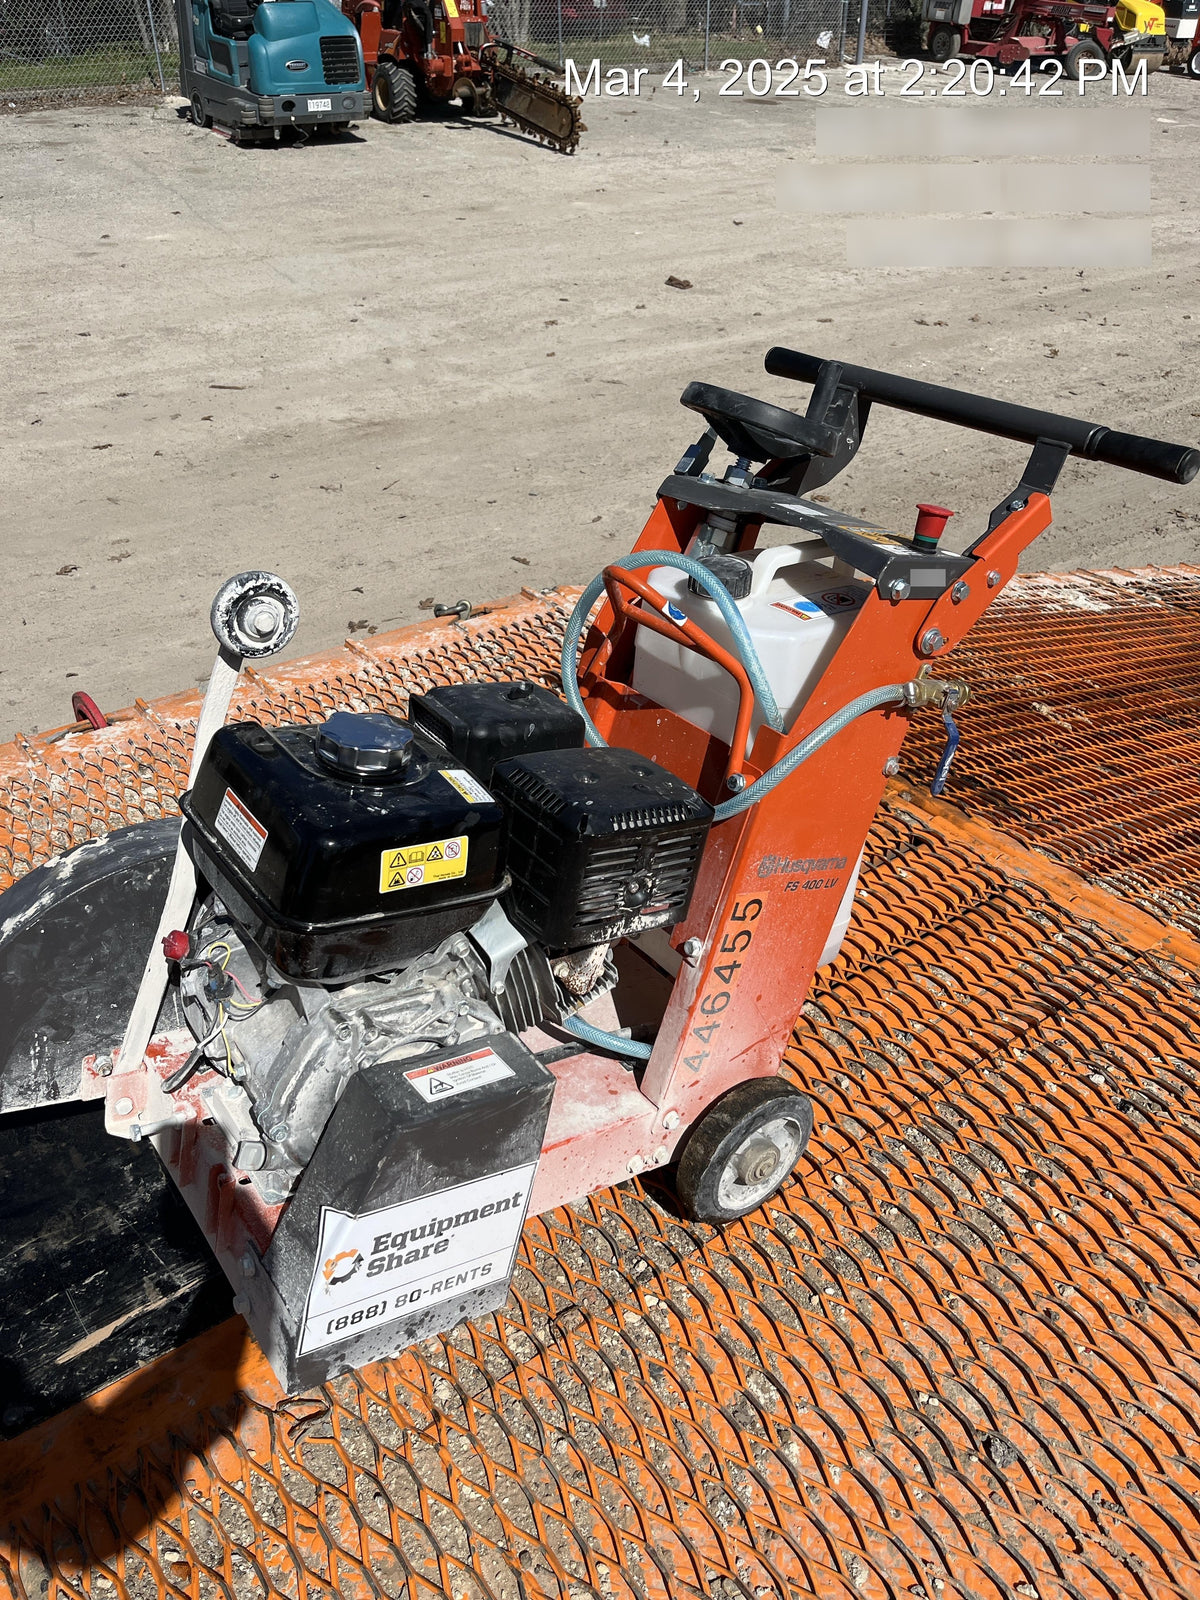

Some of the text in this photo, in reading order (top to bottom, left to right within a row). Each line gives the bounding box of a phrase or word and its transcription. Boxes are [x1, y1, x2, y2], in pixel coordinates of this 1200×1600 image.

[774, 857, 847, 875] Husqvarna
[784, 877, 839, 892] FS 400 LV
[683, 897, 763, 1073] 446455
[435, 1055, 473, 1072] WARNING
[371, 1191, 522, 1255] Equipment
[366, 1239, 449, 1279] Share
[326, 1263, 493, 1335] (888) 80-RENTS
